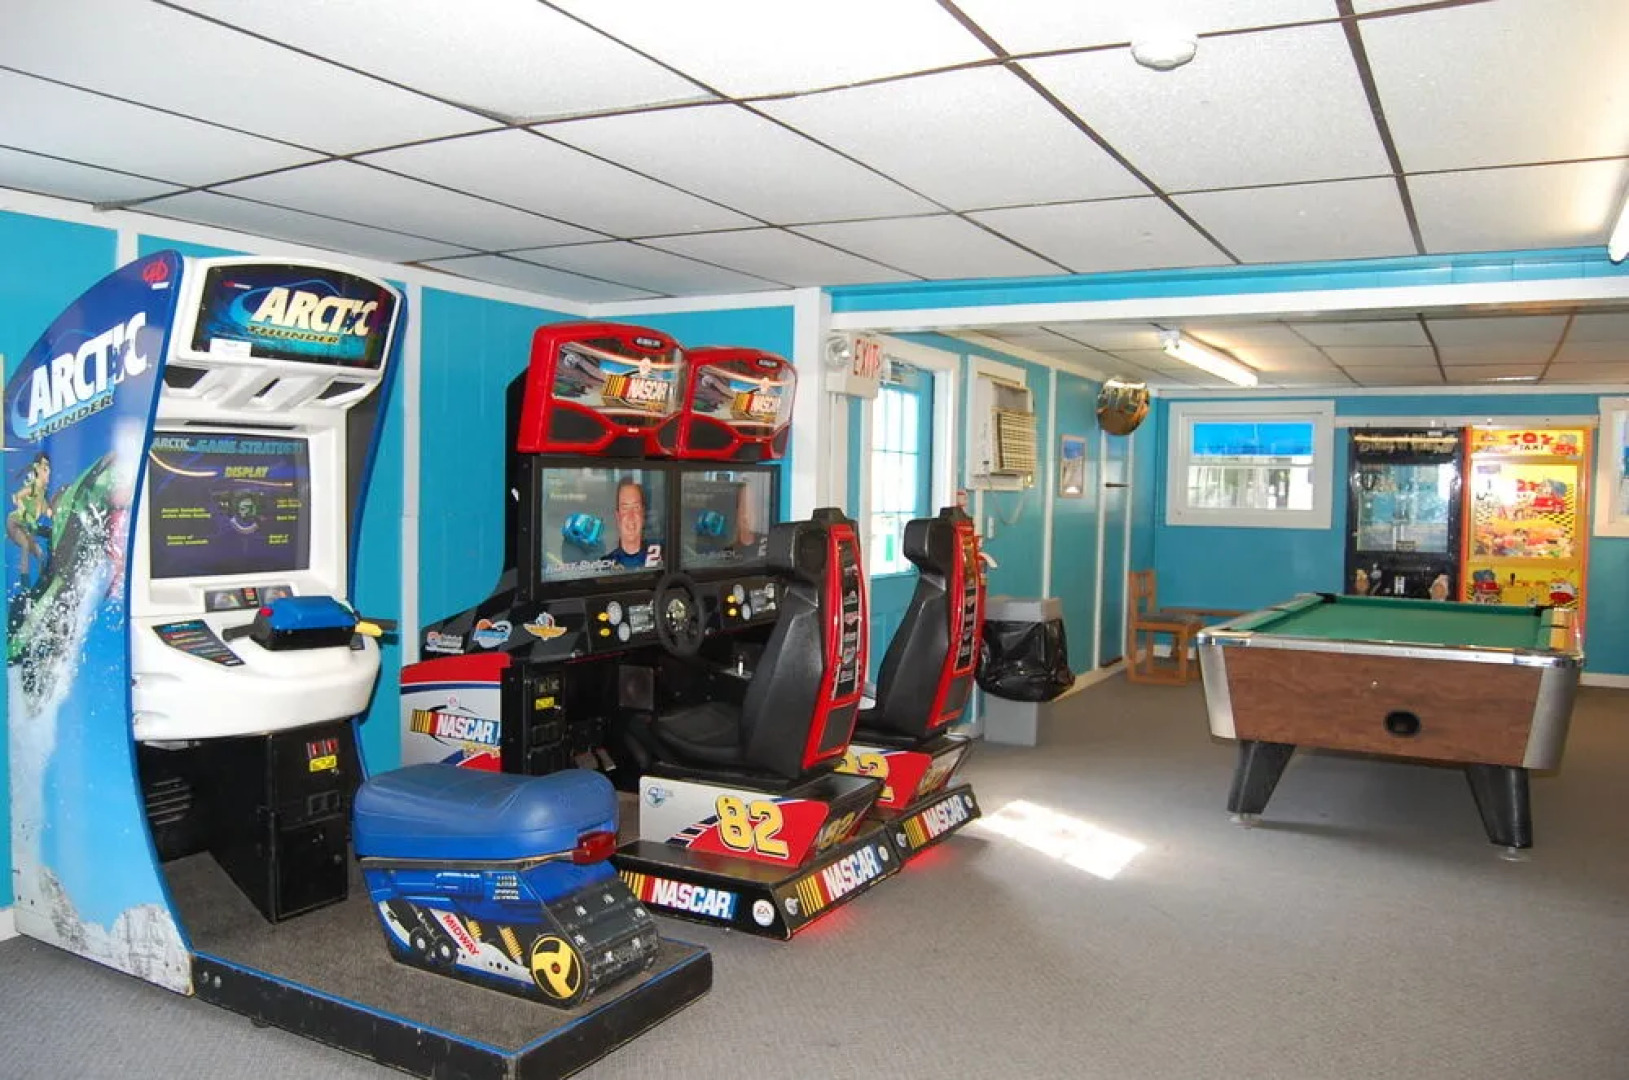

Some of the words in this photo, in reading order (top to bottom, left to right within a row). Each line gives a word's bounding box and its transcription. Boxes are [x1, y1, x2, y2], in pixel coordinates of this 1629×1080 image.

[252, 286, 377, 336] ARCTIC
[248, 325, 339, 343] THUNDER
[27, 311, 148, 427] ARCTIC
[29, 394, 114, 443] THUNDER
[225, 465, 270, 478] DISPLAY
[645, 543, 662, 568] 2
[436, 715, 496, 744] NASCAR
[715, 794, 790, 860] 82
[921, 793, 970, 839] NASCAR
[822, 845, 880, 900] NASCAR
[651, 877, 733, 920] NASCAR
[442, 913, 481, 956] MIDWAY
